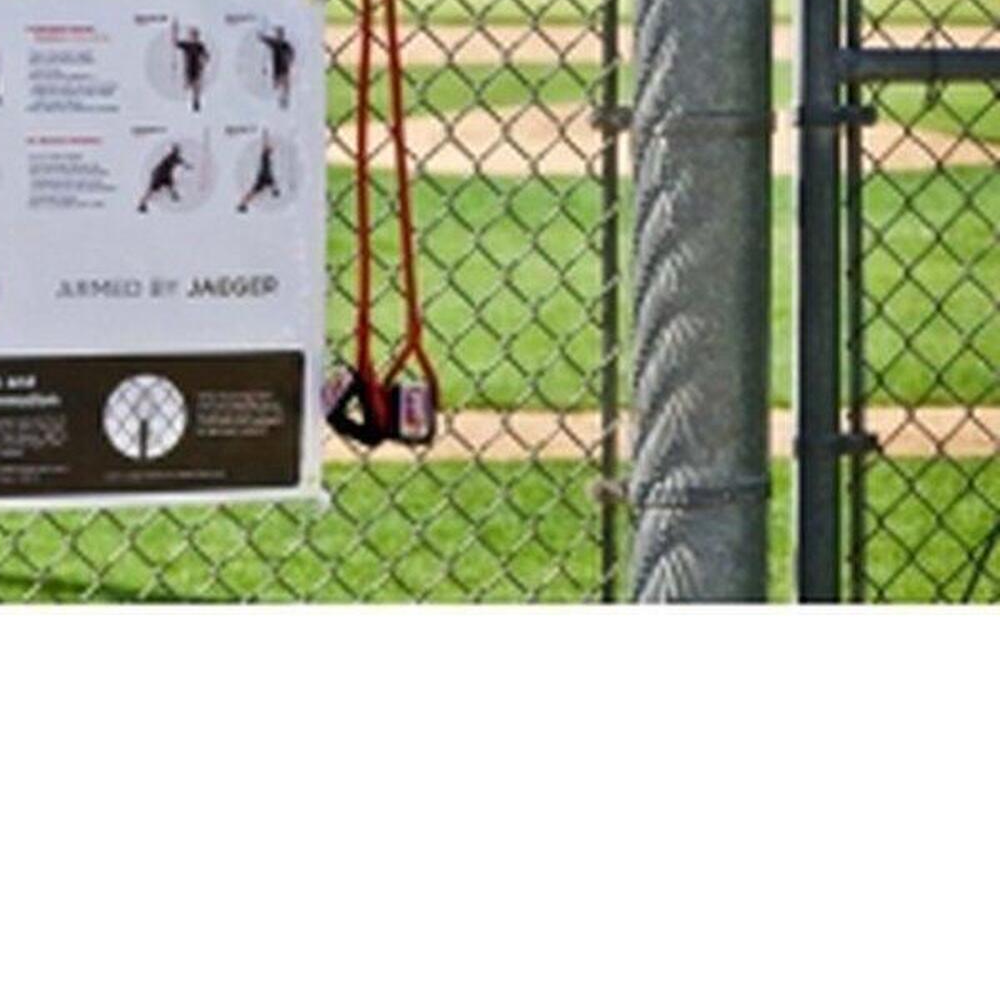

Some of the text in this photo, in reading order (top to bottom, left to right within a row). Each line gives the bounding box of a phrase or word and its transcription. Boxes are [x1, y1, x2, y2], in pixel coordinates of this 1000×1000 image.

[55, 275, 279, 298] ARMED BY JAEGER
[7, 374, 37, 388] and
